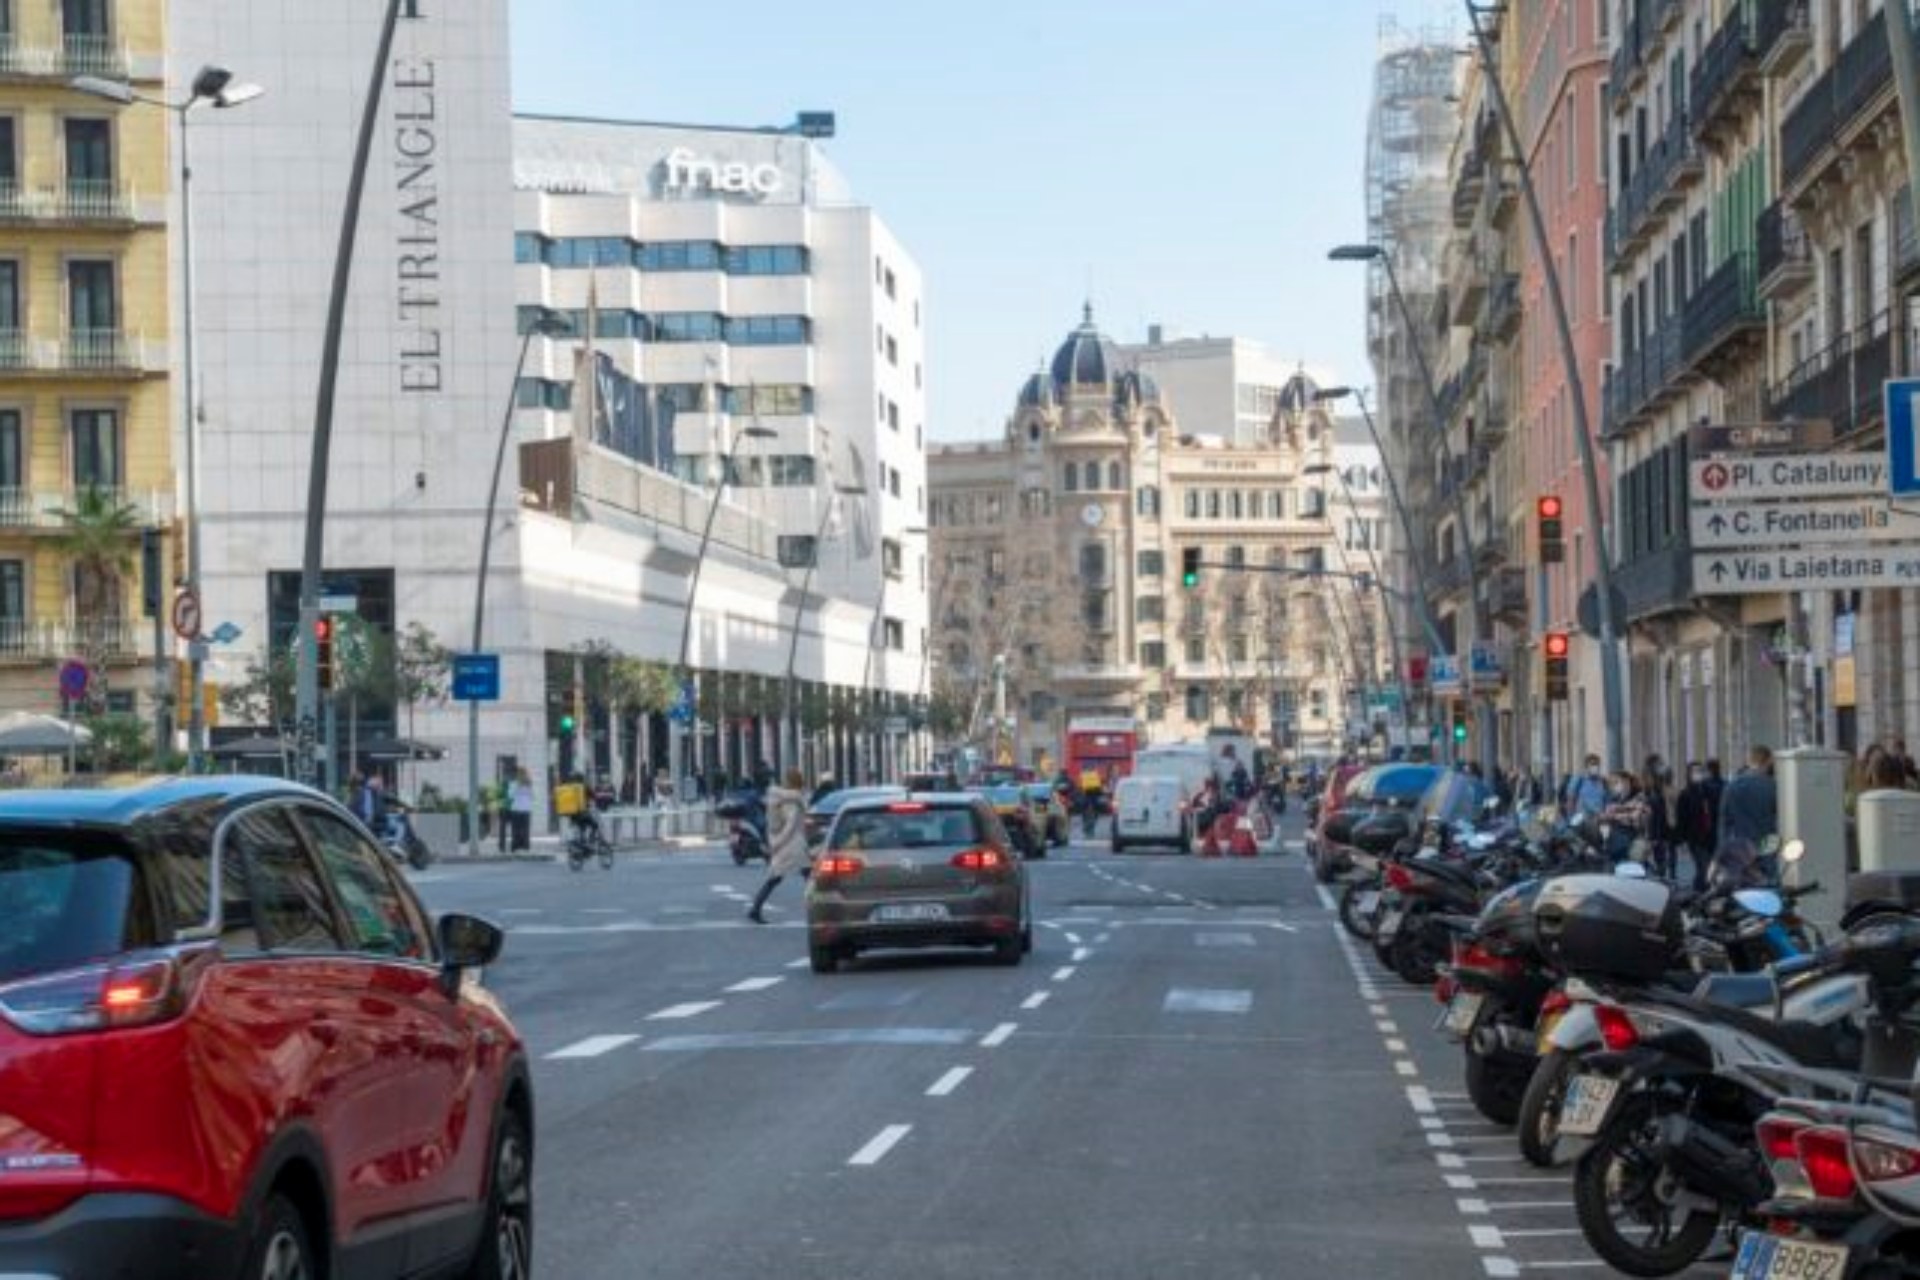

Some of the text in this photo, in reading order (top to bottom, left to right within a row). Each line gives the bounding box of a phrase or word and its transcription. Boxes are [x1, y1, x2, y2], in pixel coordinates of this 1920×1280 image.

[665, 147, 782, 192] fnac
[394, 59, 440, 321] TRIANGLE
[399, 329, 441, 393] EL
[1733, 460, 1887, 486] Pl. Cataluny
[1733, 504, 1888, 534] C. Fontanella
[1733, 557, 1771, 581] Via
[1779, 554, 1884, 578] Laietana
